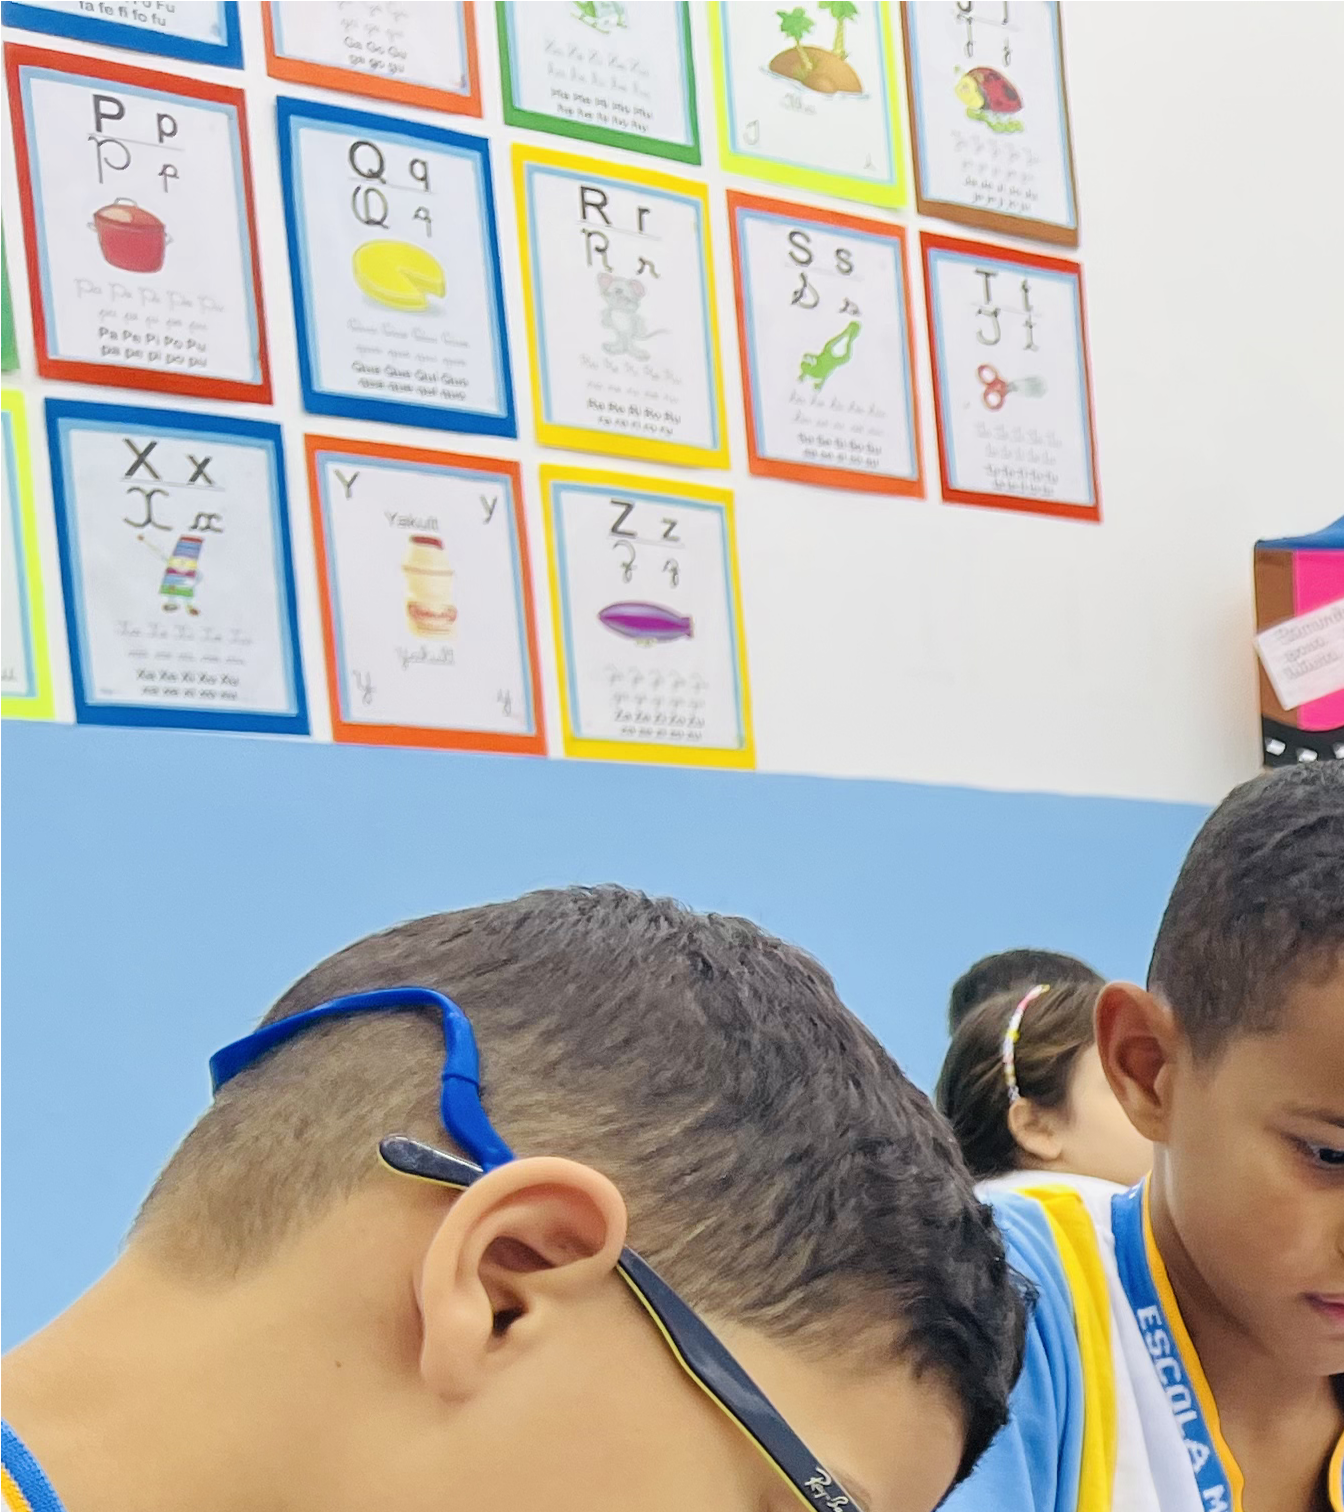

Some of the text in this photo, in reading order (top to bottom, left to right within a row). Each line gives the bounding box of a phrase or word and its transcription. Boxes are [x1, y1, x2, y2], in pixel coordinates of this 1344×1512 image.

[133, 9, 148, 22] fo
[152, 13, 166, 27] fu
[92, 94, 178, 144] P p
[87, 135, 180, 194] P p
[348, 140, 429, 192] Q q
[412, 205, 433, 238] q
[580, 186, 651, 233] R r
[581, 228, 661, 279] R r
[788, 230, 854, 275] S s
[975, 268, 998, 305] T
[124, 438, 213, 485] X x
[334, 469, 360, 500] Y
[384, 510, 440, 531] Yakult
[480, 493, 498, 525] y
[610, 498, 681, 541] Z z
[1136, 1303, 1211, 1474] ESCOLA
